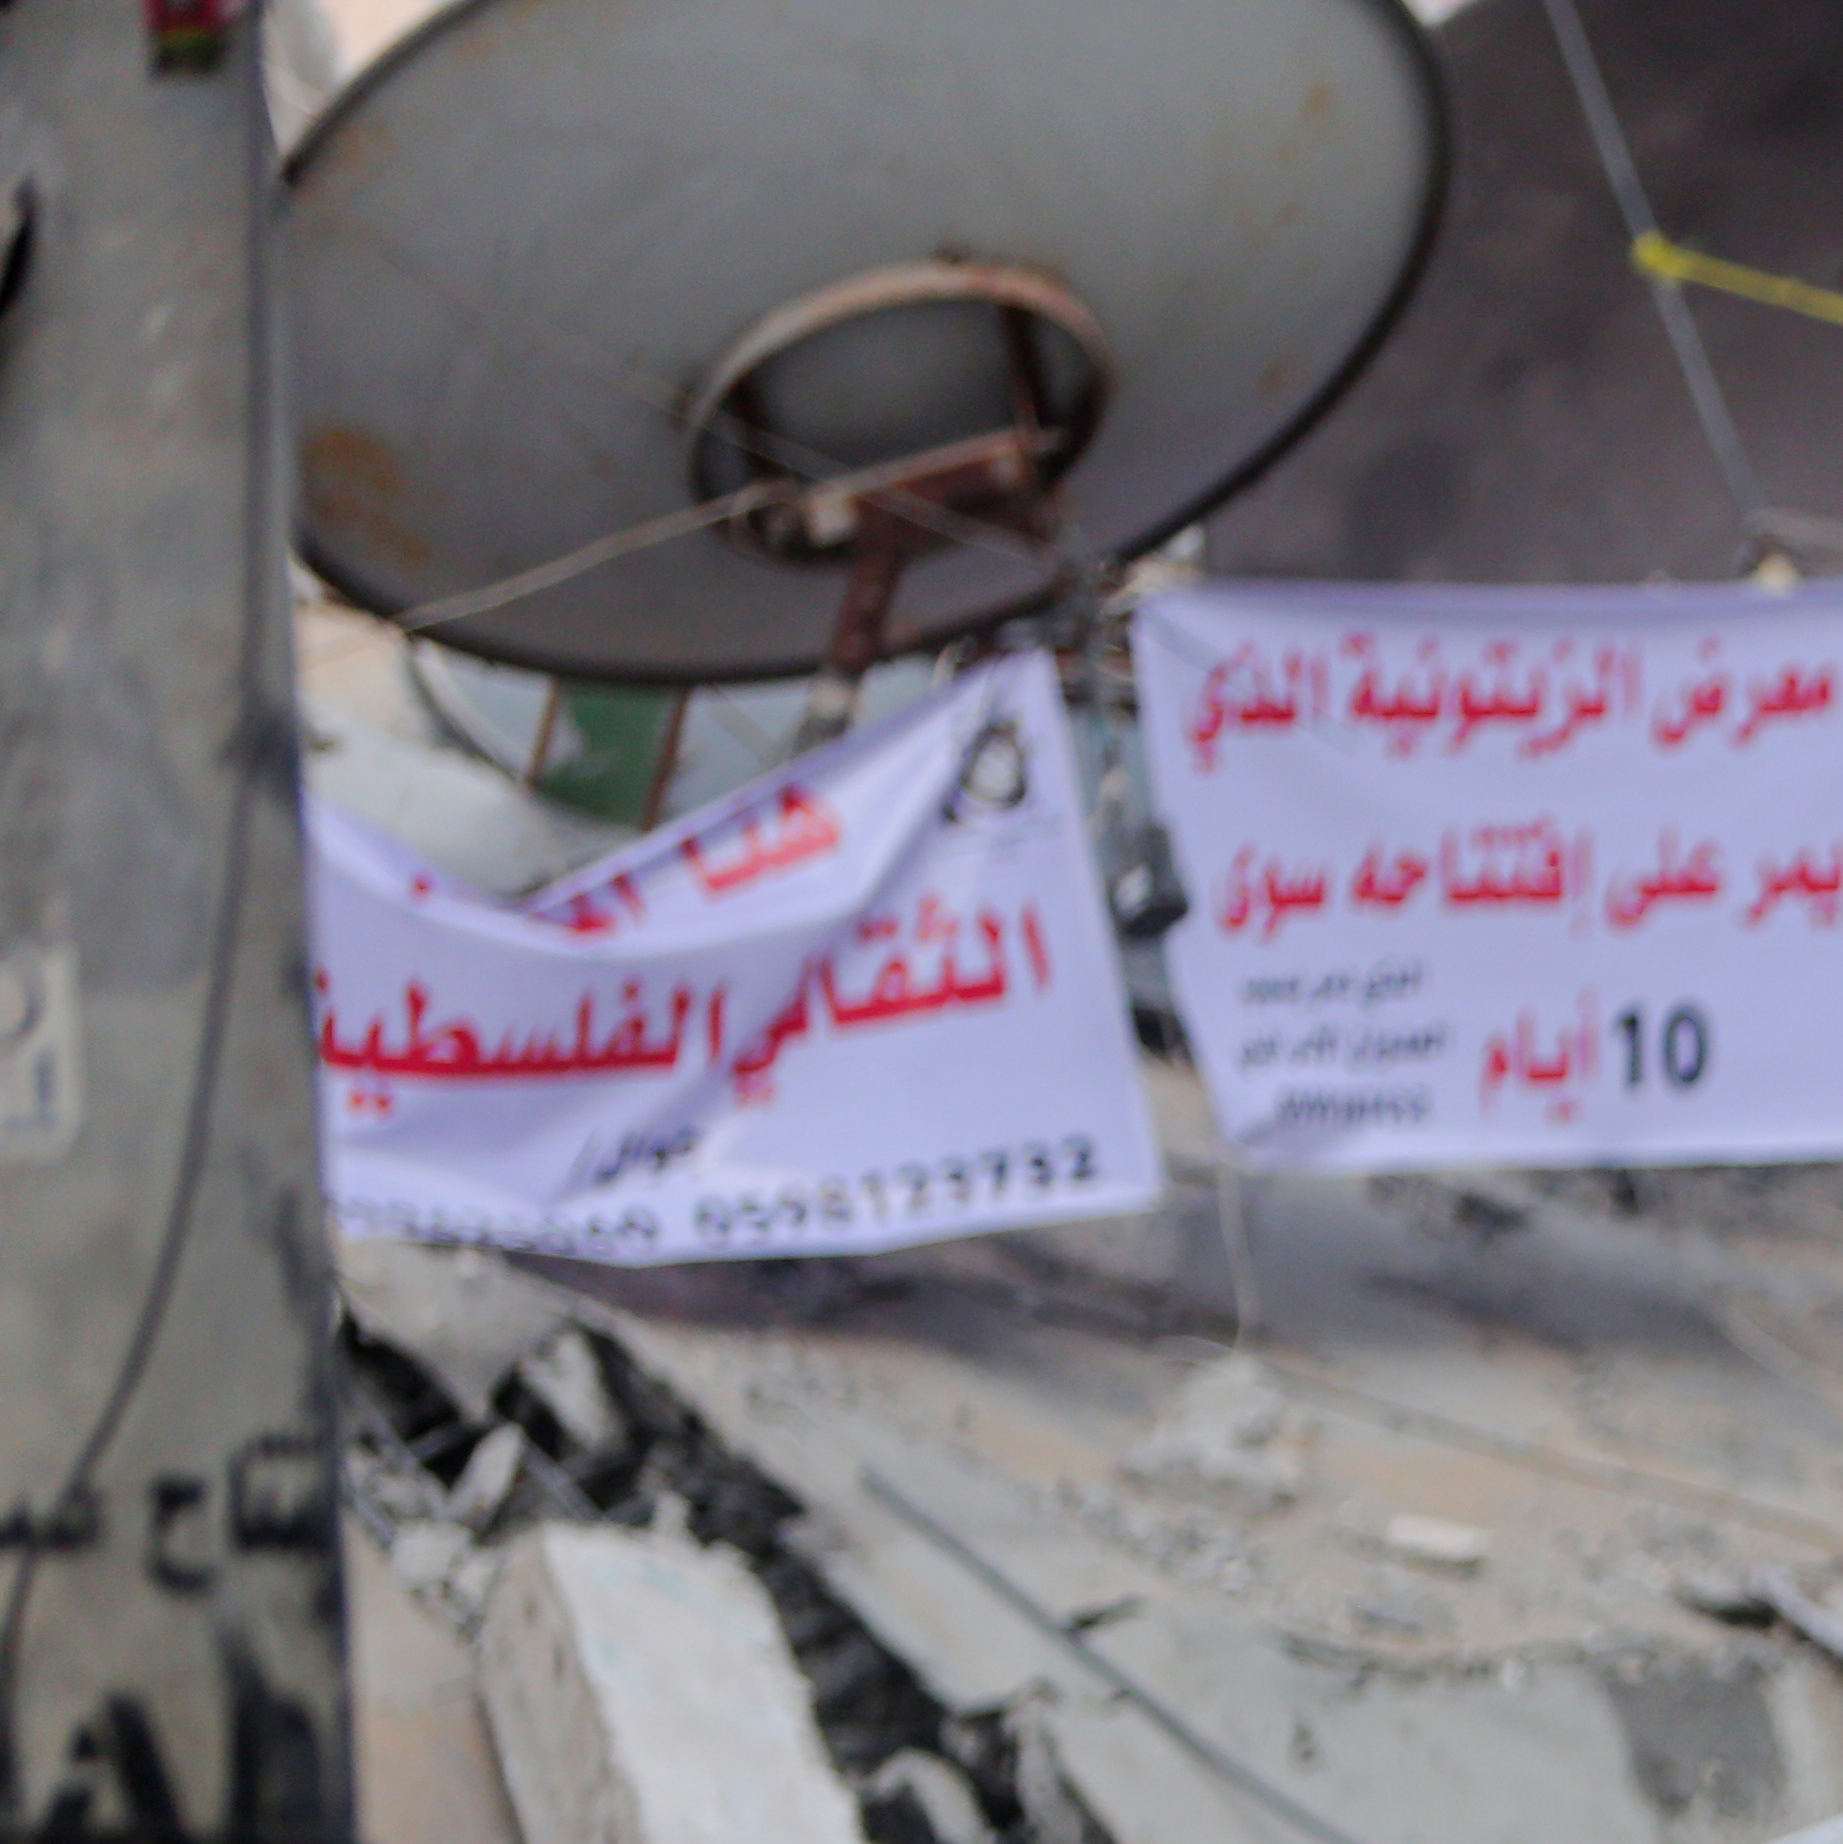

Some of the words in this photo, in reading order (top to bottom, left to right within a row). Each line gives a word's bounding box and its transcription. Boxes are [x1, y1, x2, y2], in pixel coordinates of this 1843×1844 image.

[1186, 642, 1328, 772] الذي
[1341, 630, 1640, 758] الزيتونية
[1652, 640, 1840, 751] معرض
[1604, 833, 1725, 933] على
[732, 890, 1052, 1108] الثقافي
[1616, 1006, 1710, 1090] 10
